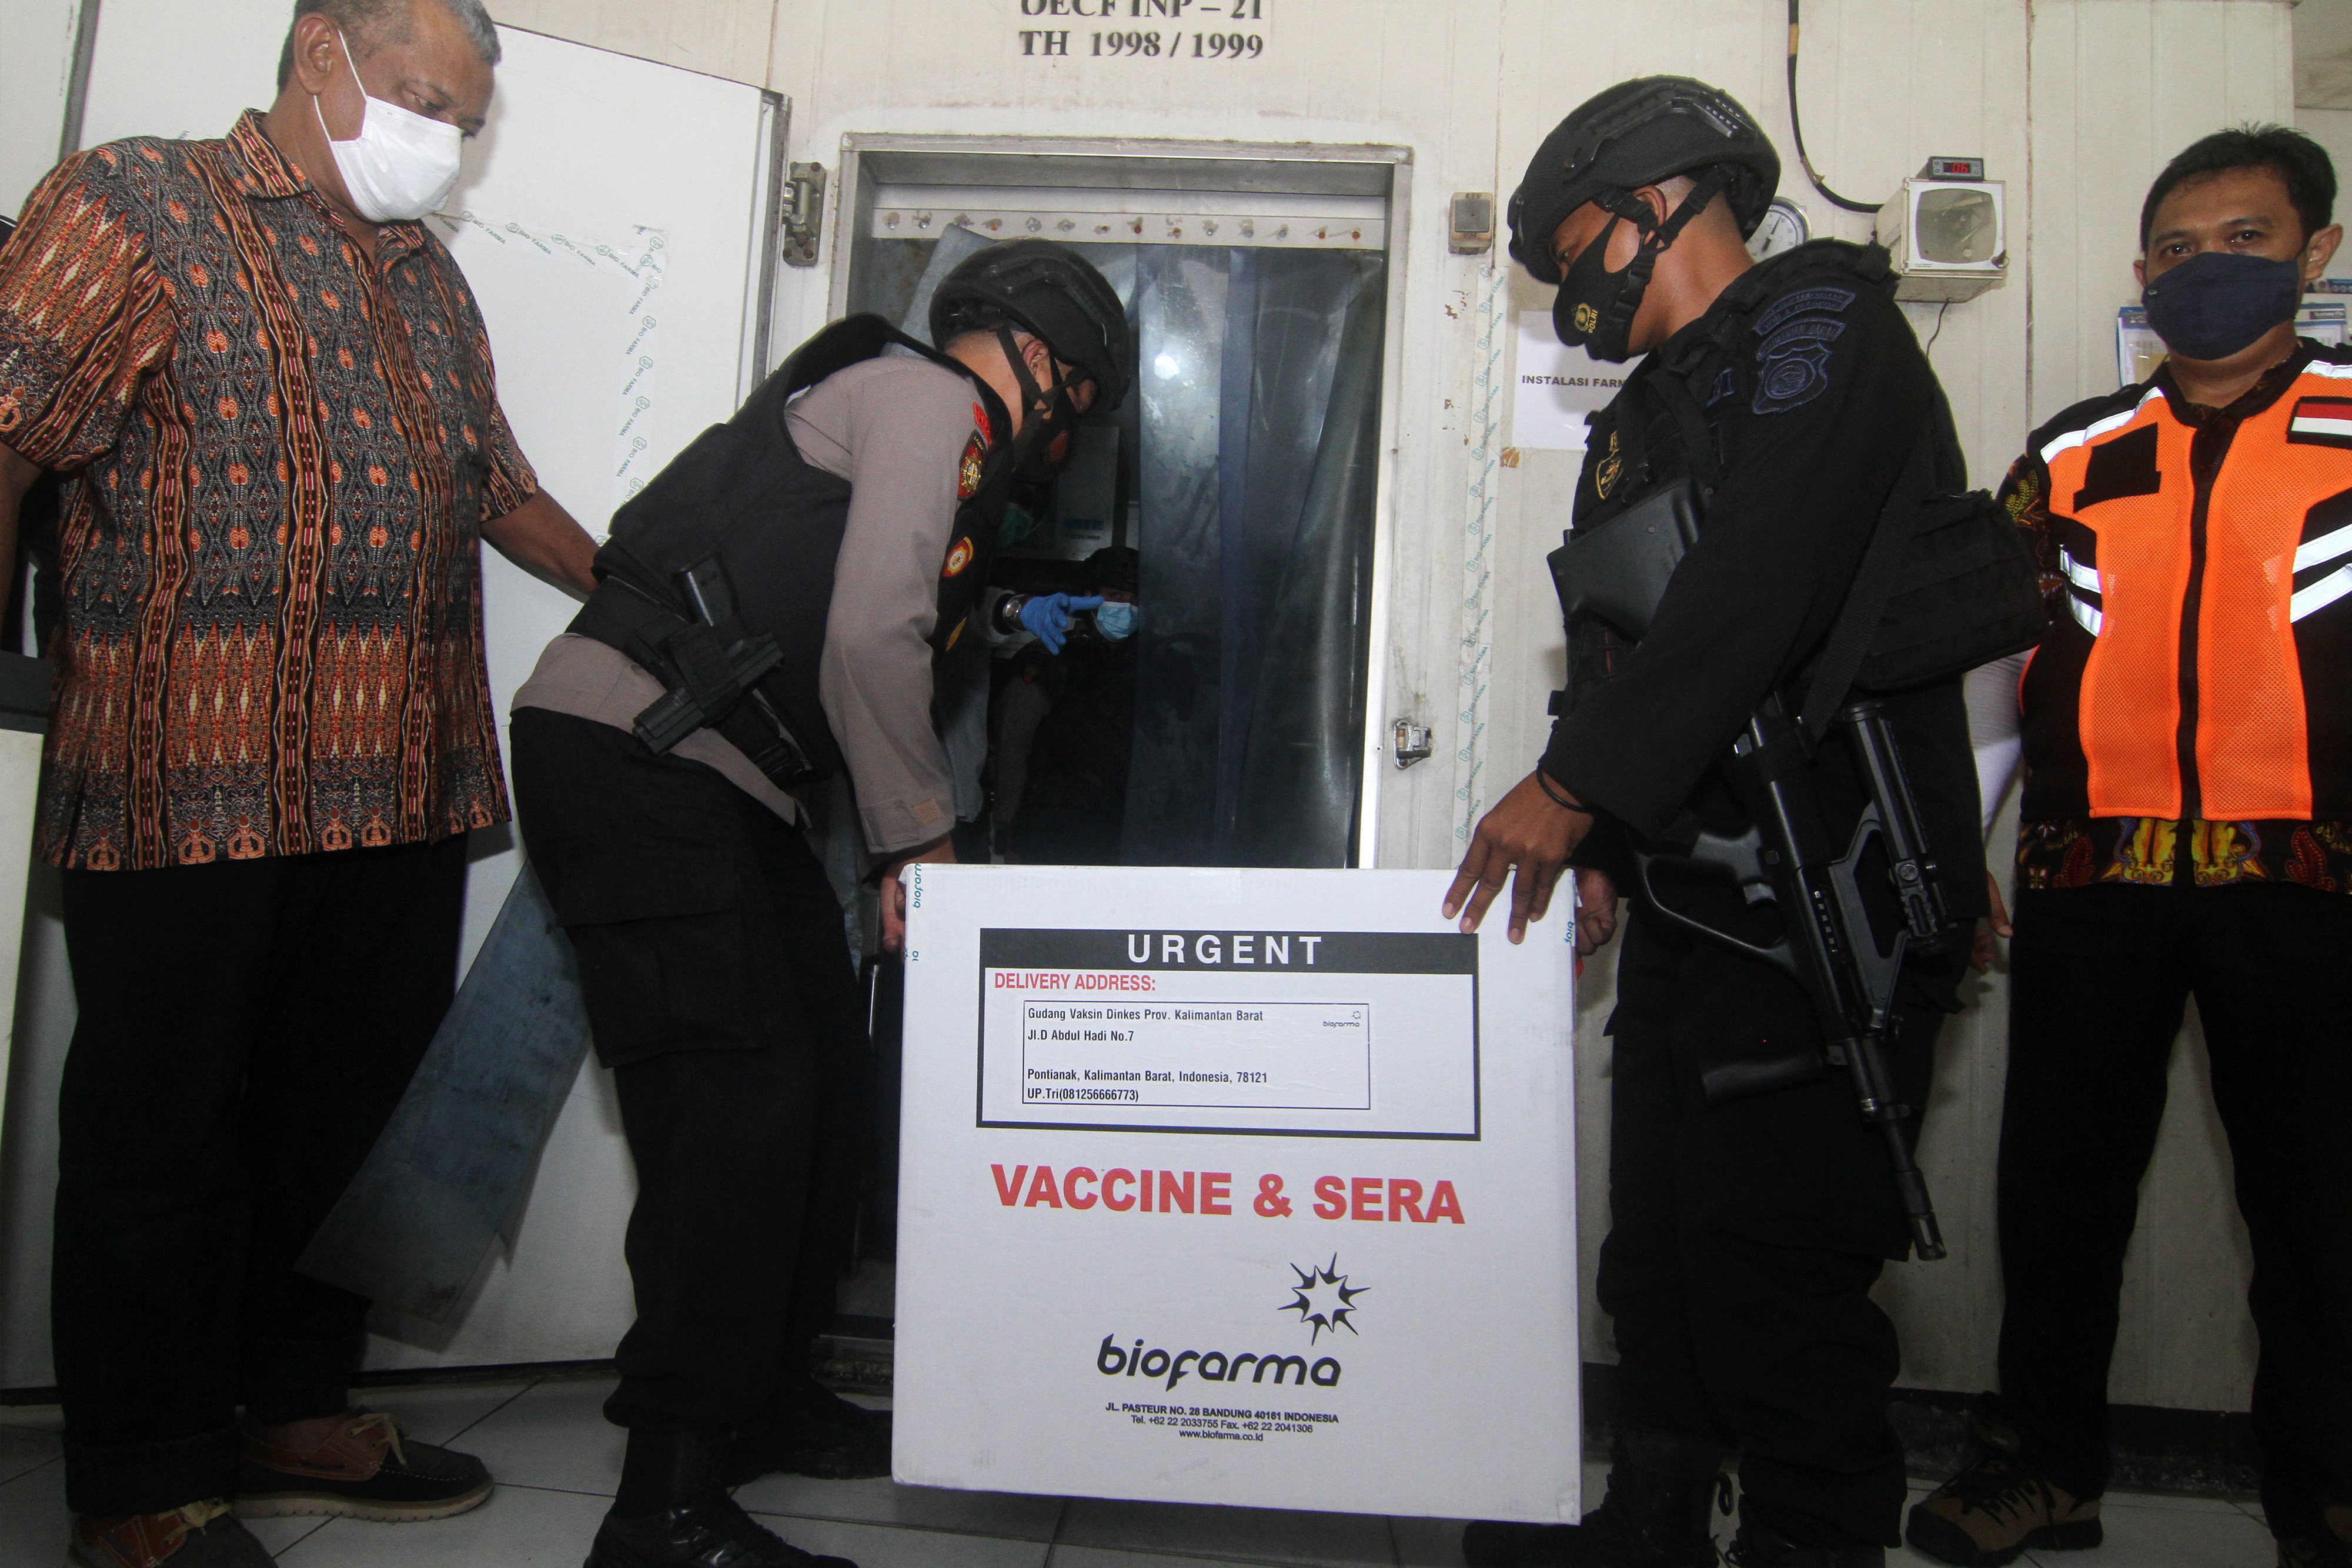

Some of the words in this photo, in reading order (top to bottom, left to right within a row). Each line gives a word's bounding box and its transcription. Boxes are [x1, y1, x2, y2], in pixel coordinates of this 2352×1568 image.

[1021, 0, 1116, 16] OECF
[1129, 0, 1192, 18] INP
[1230, 0, 1263, 19] 21
[1019, 31, 1071, 56] TH
[1090, 32, 1161, 58] 1998
[1191, 32, 1264, 59] 1999
[1588, 309, 1598, 333] POLRI
[1522, 375, 1588, 387] INSTALASI
[1127, 934, 1322, 965] URGENT
[994, 972, 1070, 990] DELIVERY
[1074, 974, 1157, 992] ADDRESS:
[1028, 1008, 1065, 1021] Gudang
[1070, 1008, 1102, 1019] Vaksin
[1107, 1008, 1140, 1019] Dinkes
[1144, 1009, 1171, 1020] Prov.
[1175, 1009, 1232, 1021] Kalimantan
[1237, 1010, 1264, 1021] Barat
[1051, 1030, 1080, 1041] Abdul
[1084, 1030, 1107, 1041] Hadi
[1111, 1031, 1134, 1041] No.7
[1028, 1069, 1081, 1082] Pontianak,
[1084, 1069, 1141, 1081] Kalimantan
[1145, 1071, 1175, 1084] Barat,
[1179, 1071, 1233, 1084] Indonesia,
[1237, 1072, 1268, 1083] 78121
[1027, 1088, 1140, 1102] UP.Tri(081256666773)
[990, 1164, 1232, 1216] VACCINE
[1252, 1174, 1294, 1219] &
[1312, 1176, 1466, 1225] SERA
[1097, 1332, 1342, 1392] biofarma
[1105, 1402, 1120, 1412] JL.
[1122, 1403, 1167, 1415] PASTEUR
[1170, 1406, 1187, 1416] NO.
[1189, 1407, 1201, 1416] 28
[1202, 1407, 1252, 1419] BANDUNG
[1254, 1410, 1281, 1420] 40161
[1284, 1412, 1339, 1423] INDONESIA
[1131, 1415, 1146, 1425] Tel.
[1148, 1416, 1165, 1426] +62
[1167, 1417, 1178, 1426] 22
[1181, 1417, 1219, 1429] 2033755
[1221, 1419, 1240, 1429] Fax.
[1242, 1421, 1259, 1431] +62
[1261, 1422, 1272, 1432] 22
[1275, 1423, 1314, 1433] 2041306
[1179, 1430, 1264, 1442] www.biofarma.co.id
